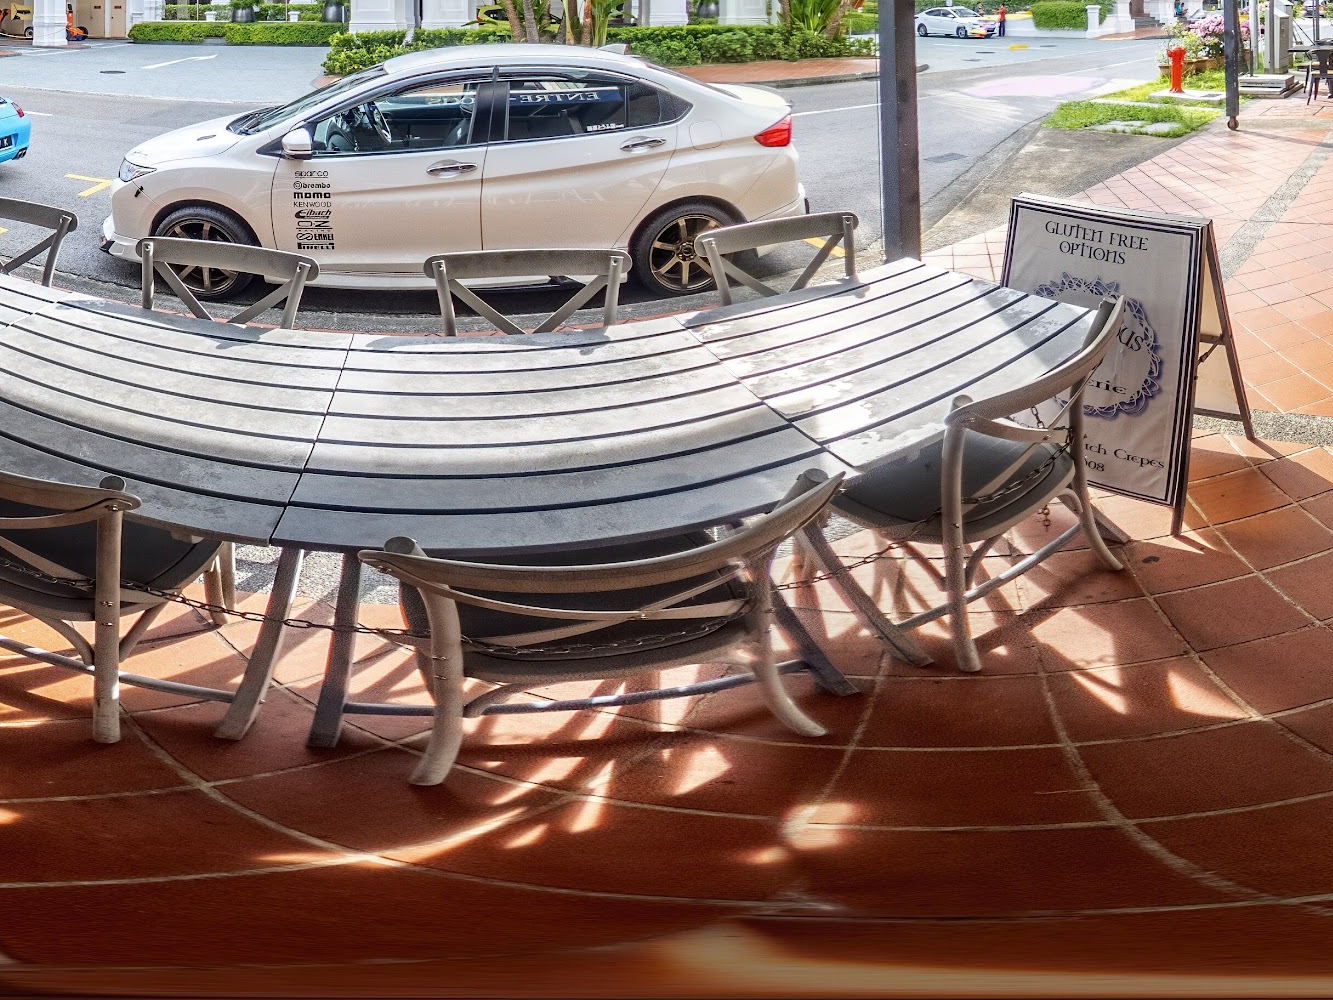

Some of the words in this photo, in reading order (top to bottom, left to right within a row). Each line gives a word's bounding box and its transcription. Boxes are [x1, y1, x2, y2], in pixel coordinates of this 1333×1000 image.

[293, 191, 331, 199] momo
[296, 208, 332, 217] Eibach
[1045, 220, 1103, 243] GLUTEN
[1109, 232, 1149, 251] FREE
[1059, 240, 1126, 265] OPTIONS
[1113, 448, 1165, 469] Crepes
